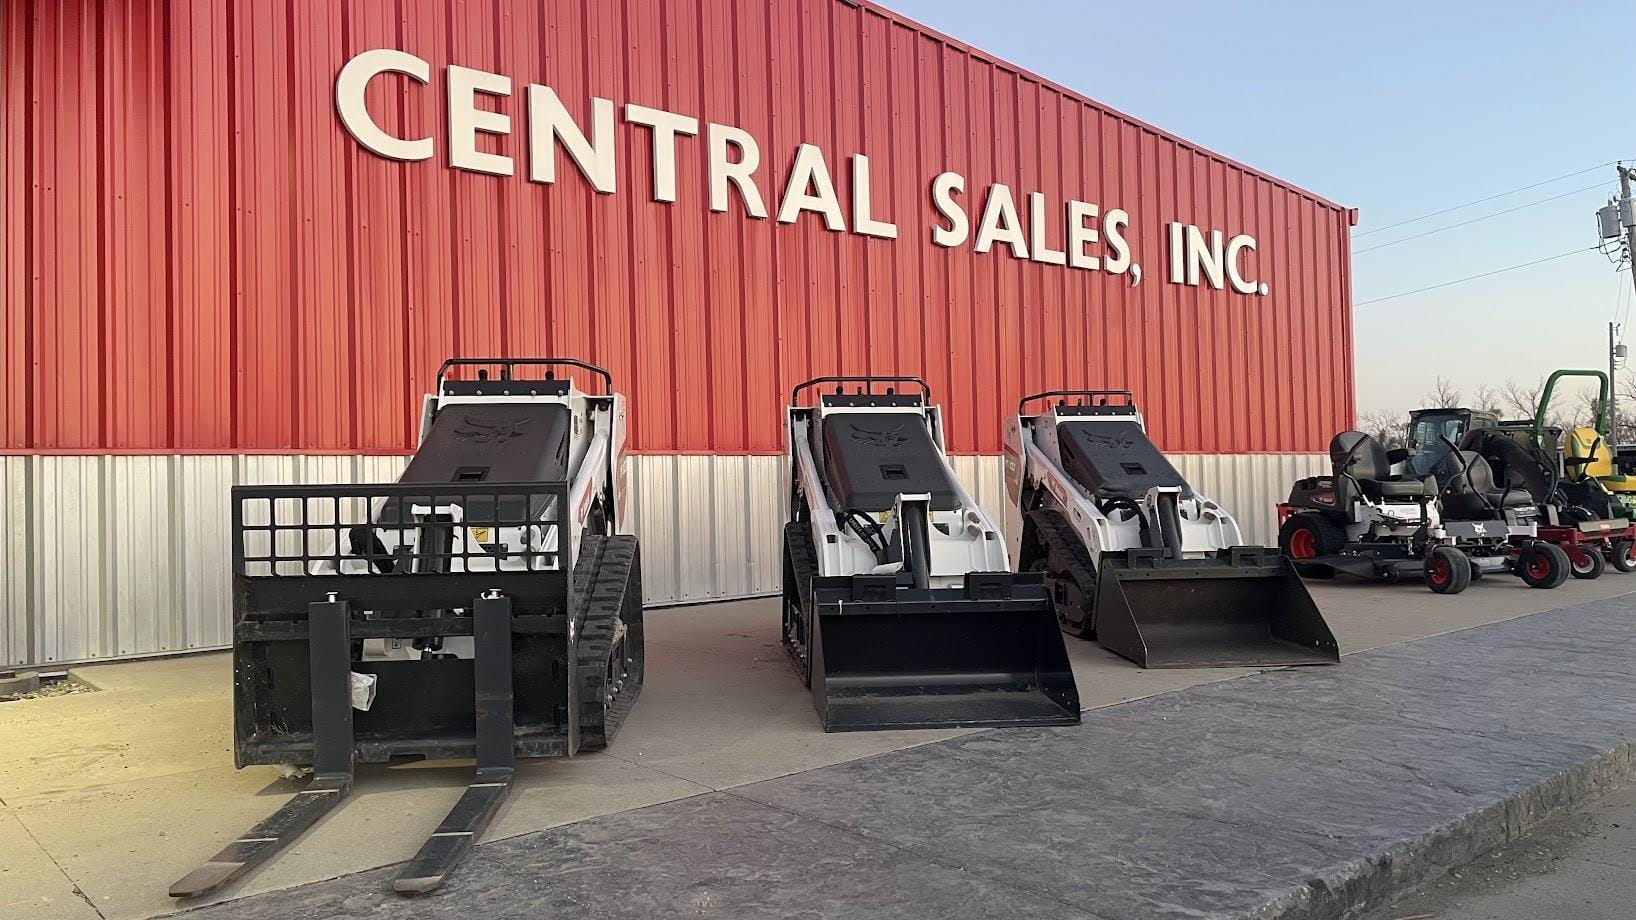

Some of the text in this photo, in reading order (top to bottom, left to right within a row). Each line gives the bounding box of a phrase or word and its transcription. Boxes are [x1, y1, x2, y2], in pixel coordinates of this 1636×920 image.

[335, 48, 1270, 297] CENTRAL SALES, INC.
